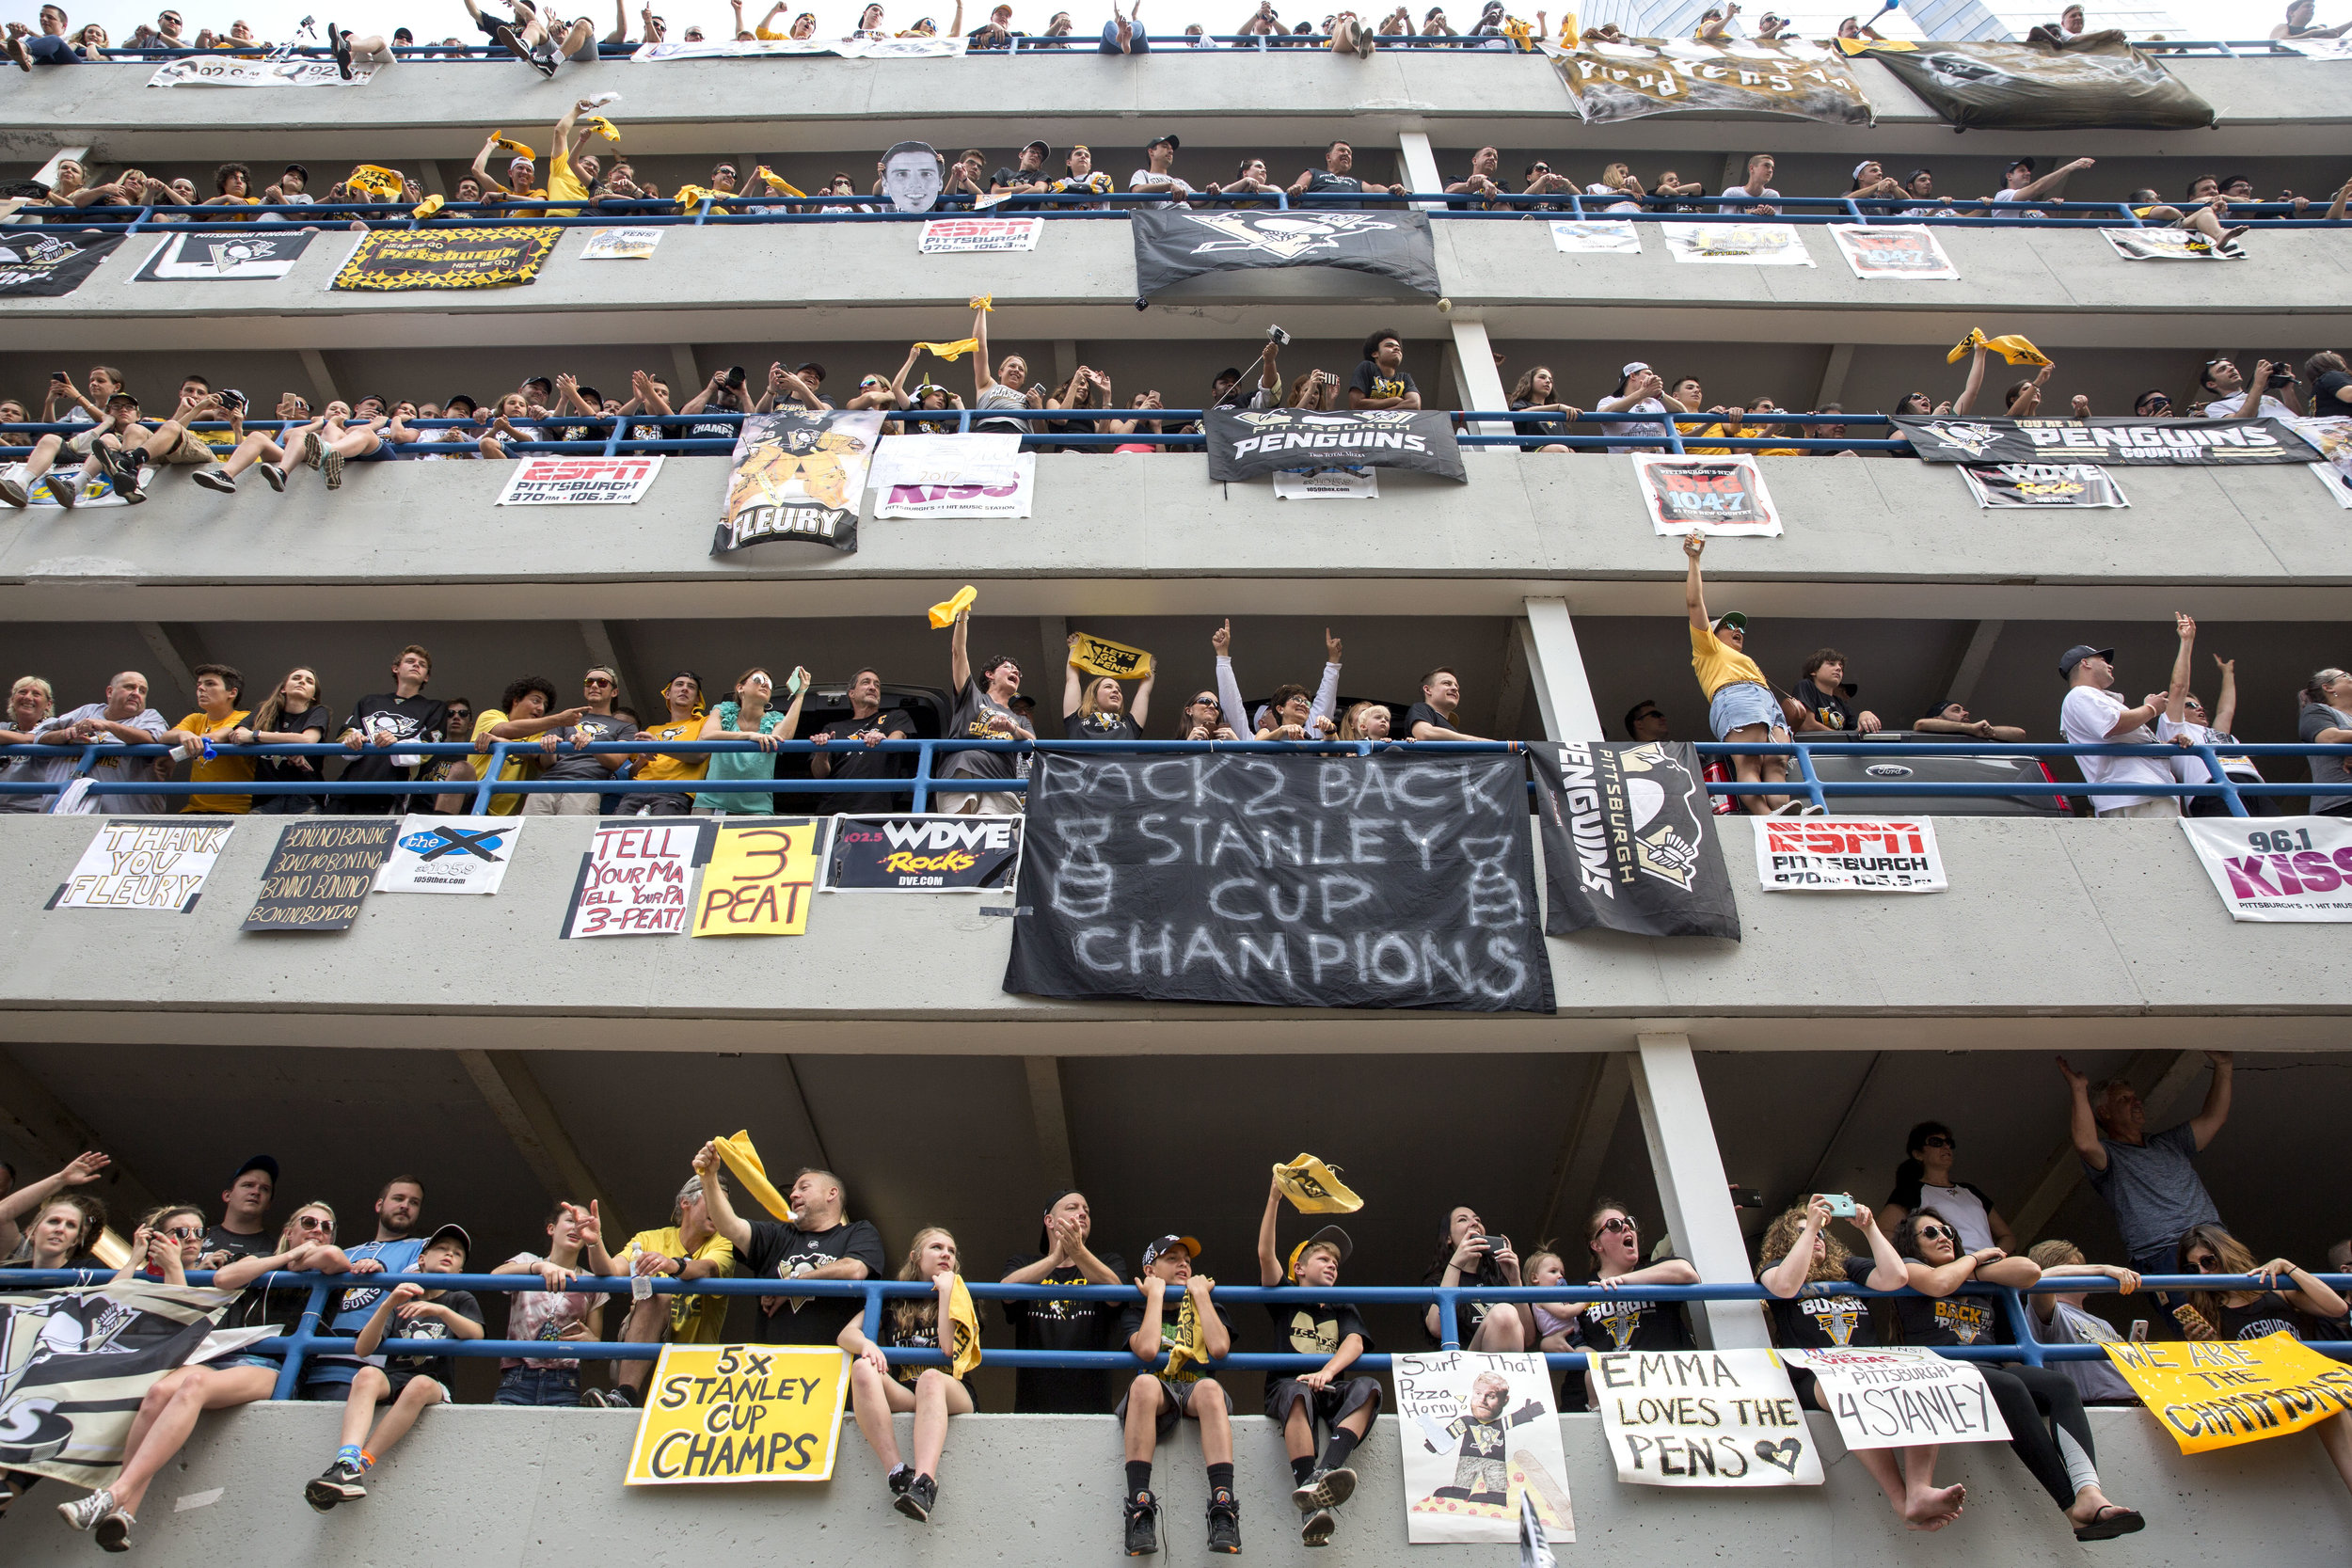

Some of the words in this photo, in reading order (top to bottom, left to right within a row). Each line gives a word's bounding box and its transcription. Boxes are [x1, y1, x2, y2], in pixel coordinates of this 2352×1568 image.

[925, 234, 1028, 245] PITTSBURGH
[928, 221, 1034, 237] ESPN
[384, 243, 407, 251] HERE
[427, 242, 443, 250] GO
[452, 261, 477, 271] HERE
[1252, 423, 1410, 433] PITTSBURGH
[2013, 420, 2063, 428] YOU'RE
[1233, 432, 1426, 459] PENGUINS
[2020, 427, 2278, 448] PENGUINS
[2119, 446, 2203, 459] COUNTRY
[521, 460, 651, 481] ESPN
[1996, 464, 2104, 482] WDVE
[515, 481, 639, 492] PITTSBURGH
[1662, 473, 1744, 493] BIG
[508, 493, 545, 501] 970
[569, 493, 614, 501] 106.3
[728, 505, 843, 549] FLEURY
[1100, 653, 1118, 663] GO
[1103, 646, 1136, 661] LET'S
[1040, 752, 1235, 807] BACK
[1243, 760, 1296, 817] 2
[1319, 759, 1508, 816] BACK
[1557, 740, 1614, 899] PENGUINS
[1598, 749, 1635, 883] PITTSBURGH
[103, 826, 229, 854] THANK
[407, 833, 439, 848] the
[595, 828, 681, 861] TELL
[844, 832, 883, 843] 102.5
[882, 819, 1011, 850] WDVE
[1136, 813, 1447, 872] STANLEY
[1766, 822, 1925, 854] ESPN
[2248, 828, 2312, 853] 96.1
[112, 850, 183, 877] YOU
[274, 851, 326, 873] BONINO
[327, 850, 383, 871] BONINO
[732, 830, 792, 882] 3
[884, 850, 977, 874] Rocks
[1772, 855, 1929, 871] PITTSBURGH
[413, 876, 467, 886] 1059thex.com
[591, 861, 645, 888] YOUR
[646, 861, 683, 883] MA
[898, 876, 944, 886] DVE.COM
[1774, 872, 1821, 887] 970
[63, 875, 203, 909] FLEURY
[259, 876, 310, 900] BONINO
[311, 874, 370, 899] BONINO
[580, 887, 623, 907] TELL
[631, 884, 662, 905] YOUR
[661, 885, 684, 906] PA
[700, 880, 813, 930] PEAT
[1208, 875, 1375, 925] CUP
[247, 905, 306, 924] BONINO
[302, 904, 359, 925] BONINO
[581, 906, 687, 933] 3-PEAT!
[1071, 923, 1530, 1001] CHAMPIONS
[1935, 1302, 1982, 1323] BACK
[1402, 1352, 1463, 1375] Surf
[1486, 1354, 1536, 1375] That
[2104, 1341, 2180, 1370] WE
[2186, 1341, 2264, 1368] ARE
[1601, 1354, 1741, 1387] EMMA
[1851, 1366, 1949, 1386] PITTSBURGH
[2187, 1368, 2272, 1391] THE
[658, 1375, 821, 1409] STANLEY
[1398, 1379, 1453, 1402] Pizza
[706, 1403, 768, 1434] CUP
[1402, 1402, 1461, 1419] Horny
[1617, 1398, 1721, 1427] LOVES
[1729, 1398, 1800, 1427] THE
[1838, 1392, 1868, 1436] 4
[1863, 1381, 1990, 1436] STANLEY
[650, 1432, 818, 1479] CHAMPS
[1626, 1433, 1749, 1479] PENS
